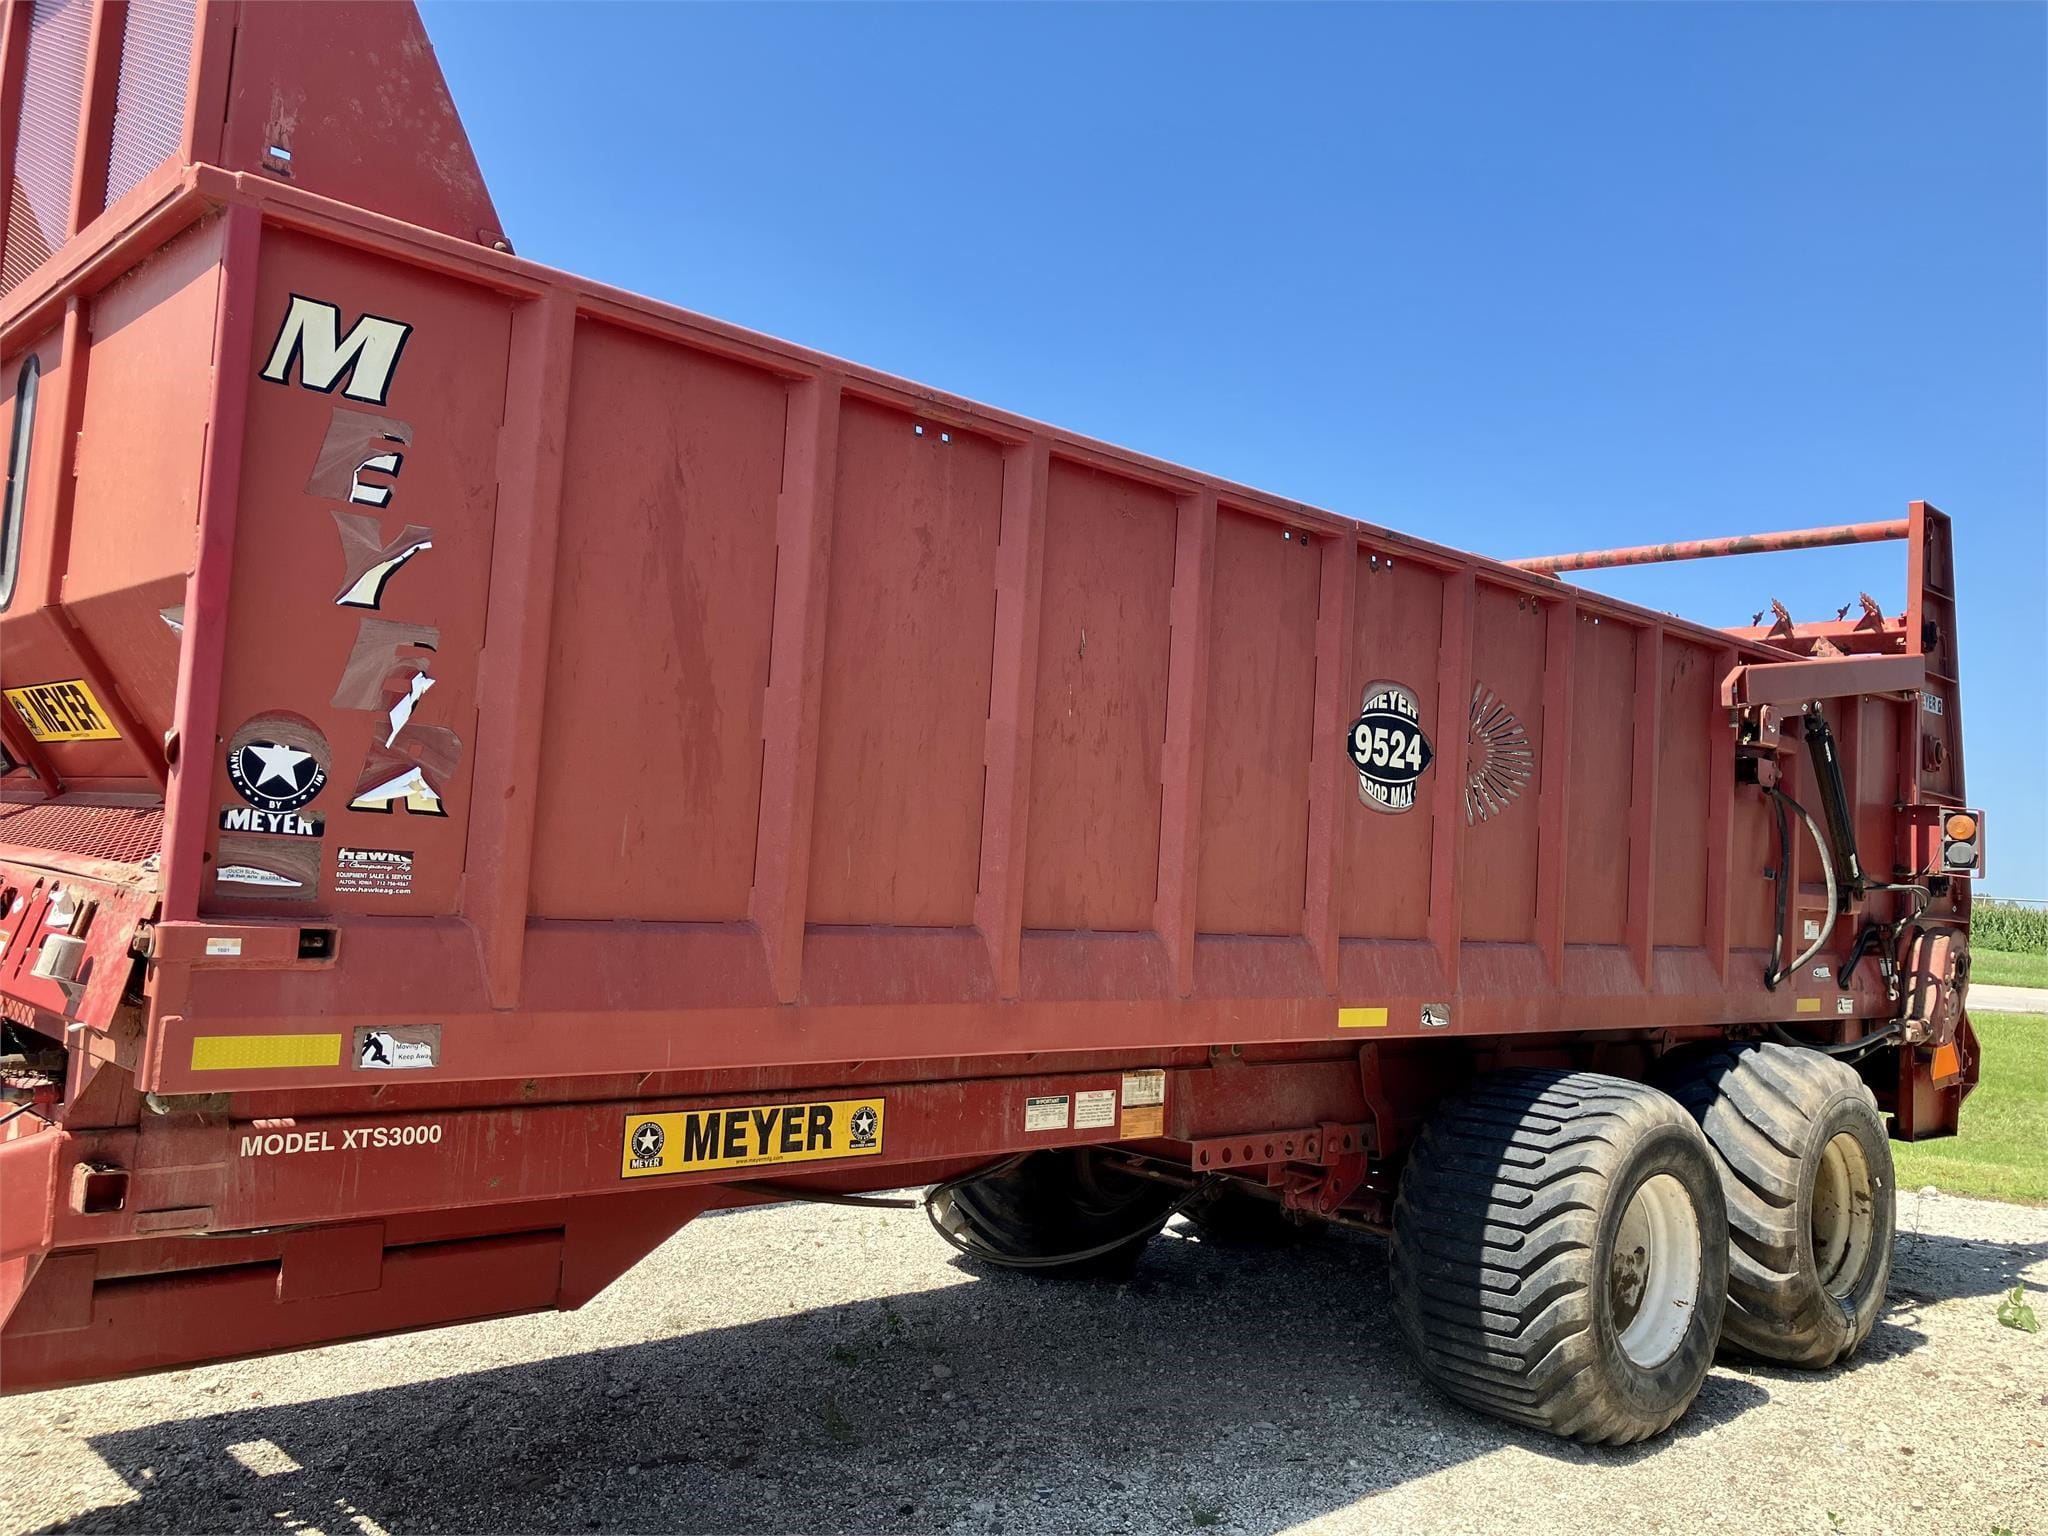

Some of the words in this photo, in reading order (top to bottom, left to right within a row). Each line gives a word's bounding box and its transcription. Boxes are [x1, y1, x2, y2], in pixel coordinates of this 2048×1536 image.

[22, 684, 106, 733] MEYER
[1355, 724, 1422, 771] 9524
[268, 800, 282, 809] BY
[1390, 782, 1414, 807] MAX
[335, 886, 411, 895] www.hawkeag.com
[240, 1131, 335, 1157] MODEL
[341, 1124, 442, 1150] XTS3000
[683, 1104, 833, 1162] MEYER
[631, 1158, 660, 1169] MEYER
